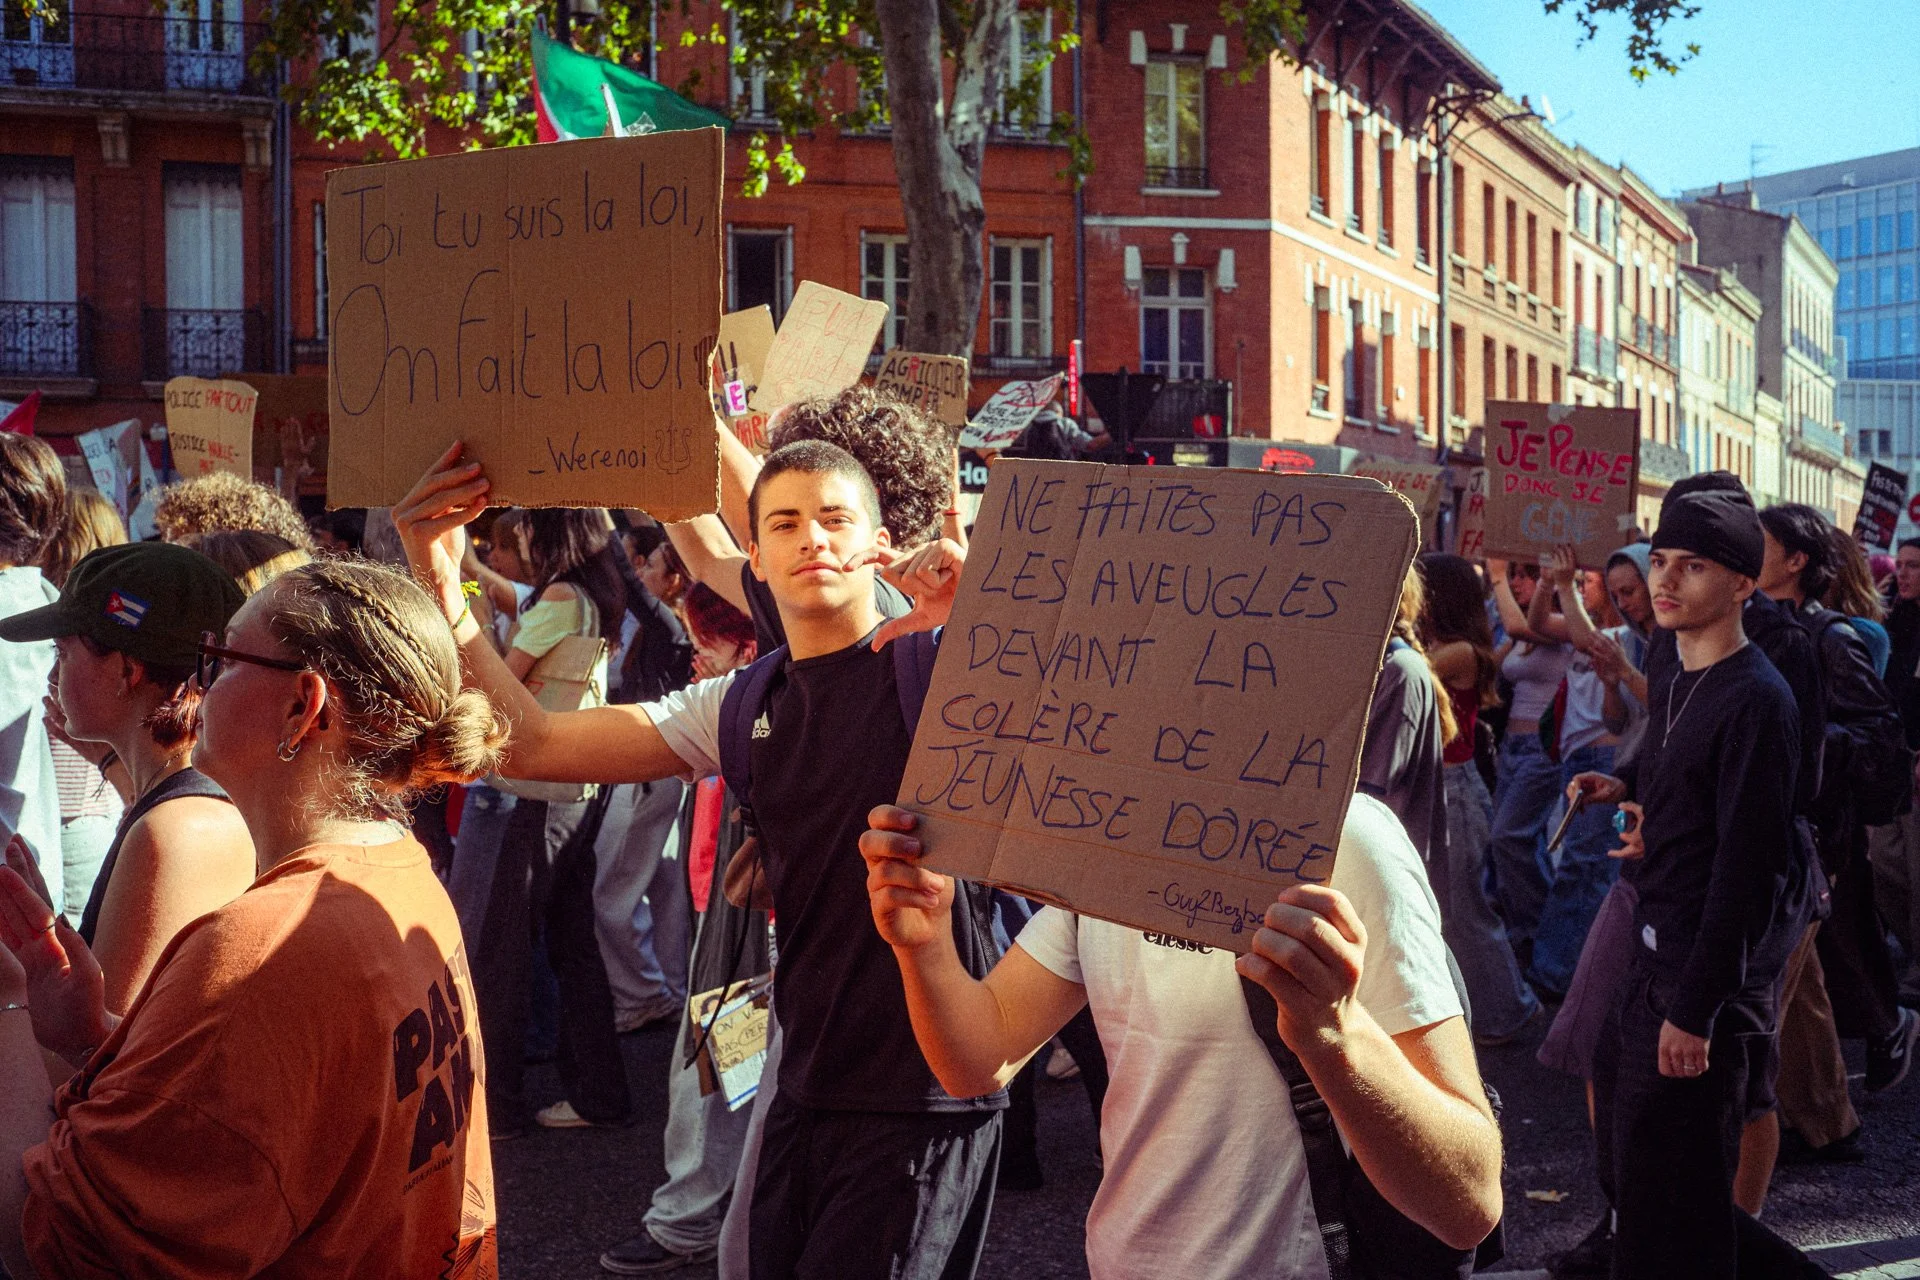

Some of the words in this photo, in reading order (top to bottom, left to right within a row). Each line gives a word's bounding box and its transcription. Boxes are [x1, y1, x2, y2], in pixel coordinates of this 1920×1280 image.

[342, 185, 402, 264] Toi
[435, 193, 481, 249] tu
[505, 198, 563, 239] suis
[585, 170, 613, 232] la
[641, 162, 704, 237] loi,
[334, 284, 439, 415] On
[458, 269, 542, 398] fait
[564, 300, 607, 393] la
[628, 299, 682, 392] loi
[204, 387, 255, 415] PARTOUT
[1497, 420, 1545, 471] JE
[1549, 423, 1633, 486] PENSE
[1505, 473, 1561, 498] DONC
[1571, 482, 1607, 504] JE
[1001, 473, 1066, 535] NE
[1251, 489, 1346, 546] PAS
[980, 547, 1067, 604] LES
[1091, 560, 1347, 619] AVEUGLES
[968, 623, 1155, 688] DEVANT
[1194, 628, 1276, 691] LA
[941, 690, 1118, 755] COLÈRE
[1154, 725, 1215, 770] DE
[1239, 730, 1330, 788] LA
[916, 739, 1139, 840] JEUNESSE
[1163, 799, 1333, 882] DORÉE
